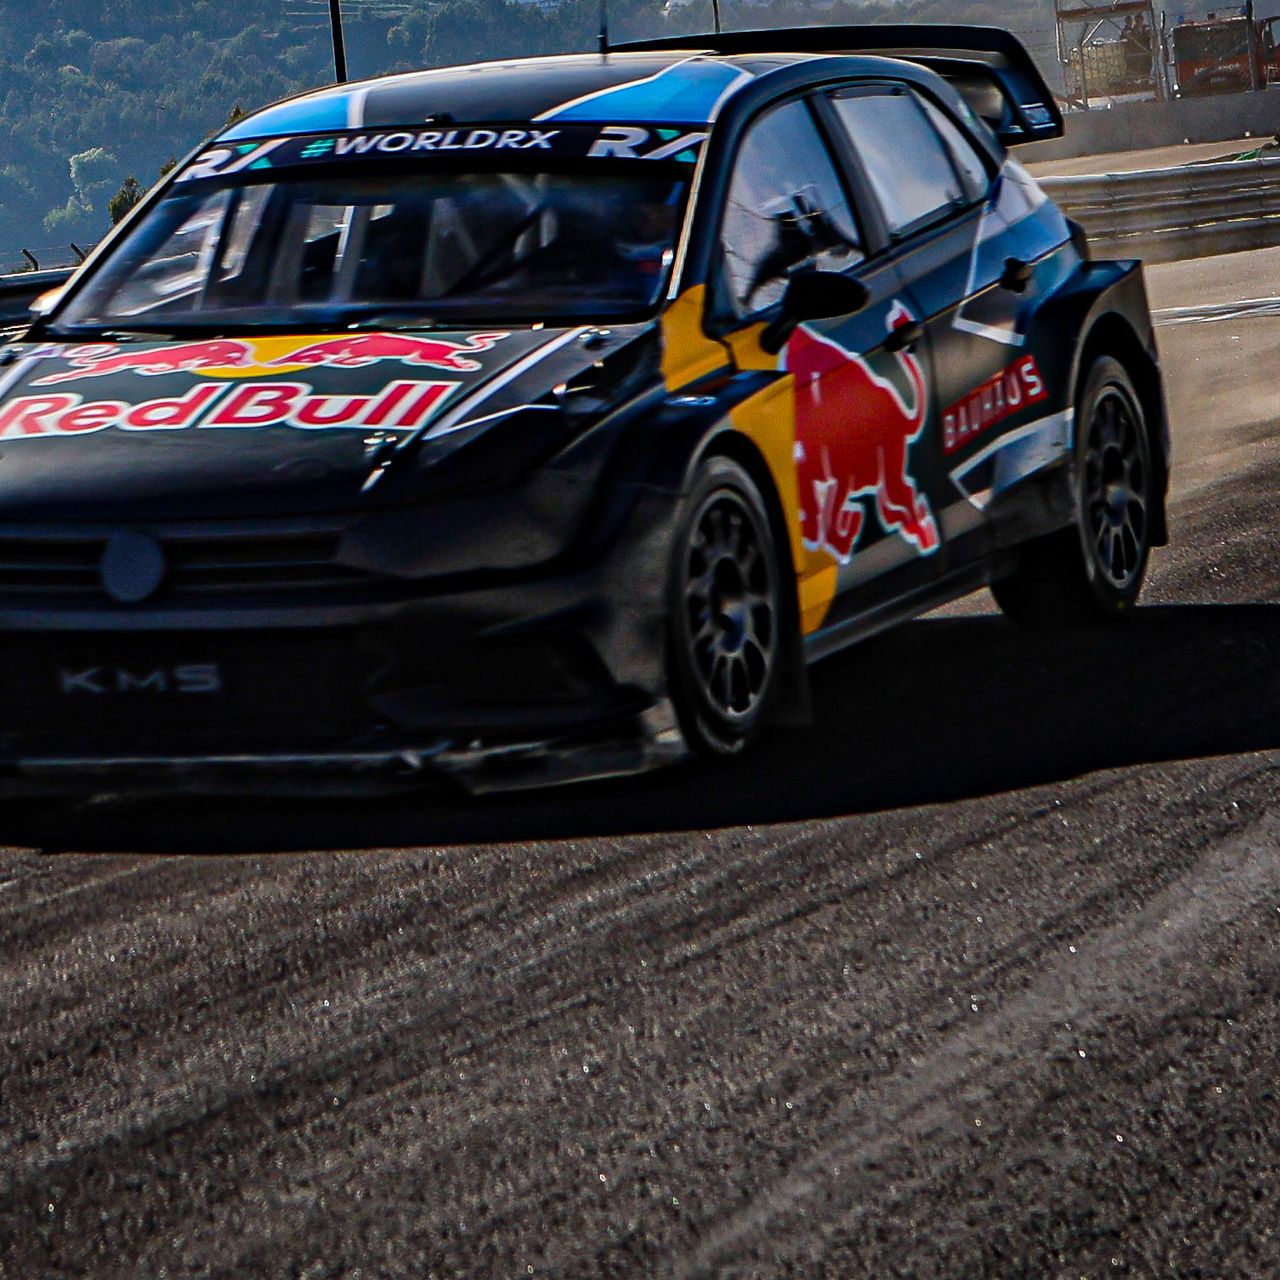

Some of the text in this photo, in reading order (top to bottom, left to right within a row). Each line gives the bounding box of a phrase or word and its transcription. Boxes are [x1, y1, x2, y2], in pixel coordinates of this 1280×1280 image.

[299, 129, 561, 158] #WORLDRX
[585, 126, 710, 162] RX
[210, 381, 460, 430] Bull
[61, 664, 221, 693] KMS
